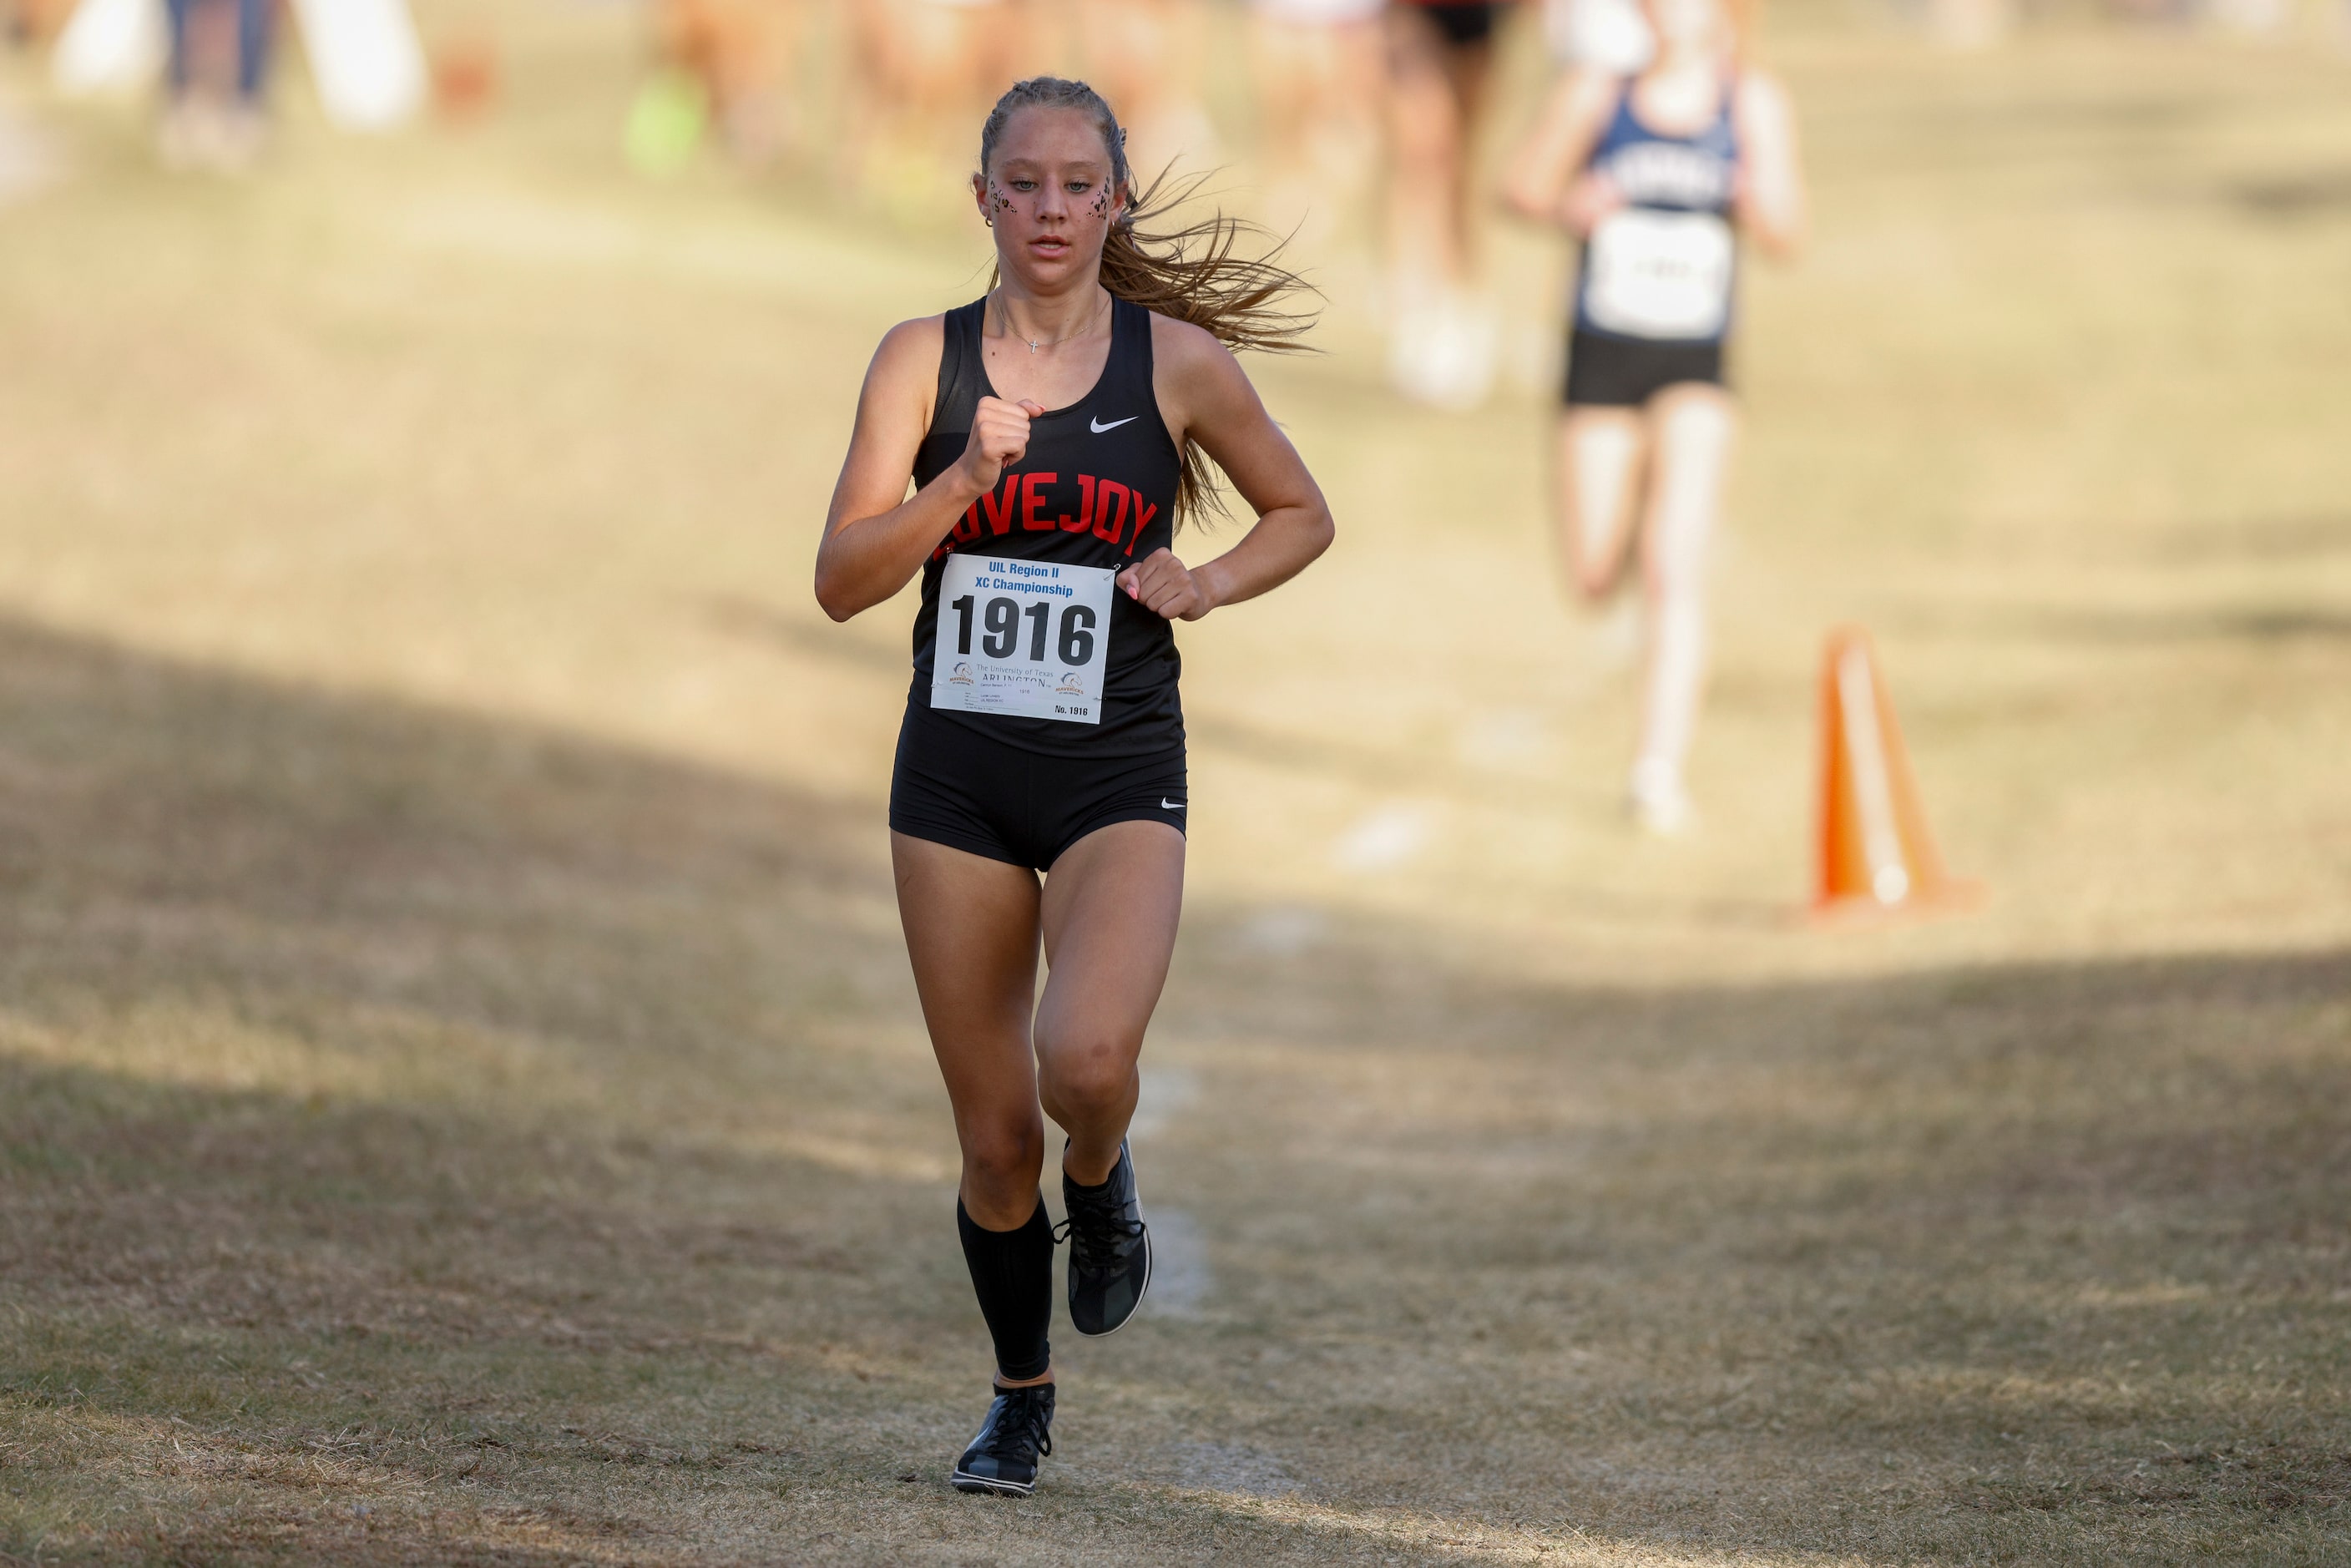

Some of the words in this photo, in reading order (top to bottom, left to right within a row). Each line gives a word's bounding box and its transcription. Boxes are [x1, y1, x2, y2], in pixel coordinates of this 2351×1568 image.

[933, 472, 1158, 561] OVEJOY
[988, 561, 1006, 574] UIL
[1009, 563, 1048, 577] Region
[1051, 567, 1059, 579] II
[975, 576, 990, 589] XC
[993, 578, 1073, 598] Championship
[952, 594, 1096, 666] 1916
[976, 664, 988, 672] The
[991, 665, 1023, 676] University
[1054, 705, 1067, 714] No.
[1069, 706, 1088, 716] 1916
